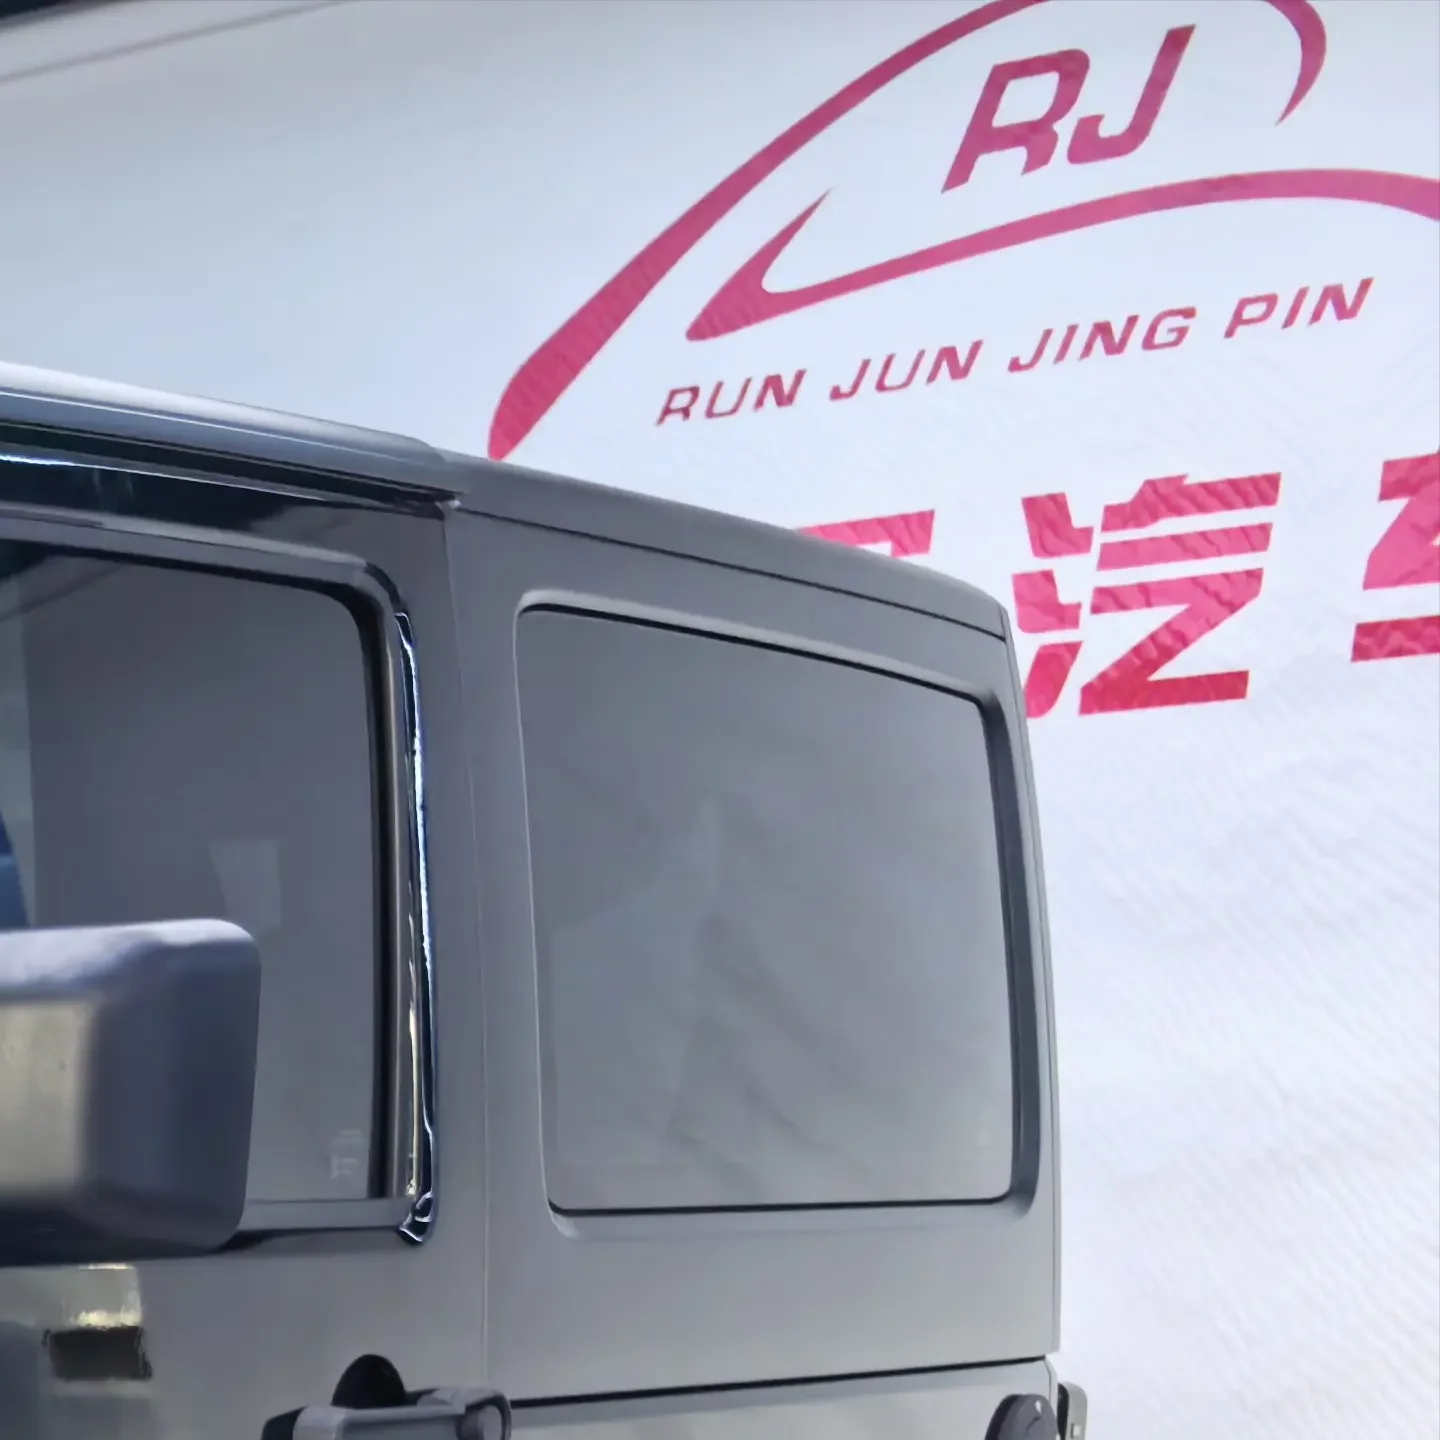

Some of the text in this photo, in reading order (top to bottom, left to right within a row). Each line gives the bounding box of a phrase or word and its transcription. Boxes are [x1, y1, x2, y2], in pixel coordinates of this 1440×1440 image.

[941, 24, 1197, 194] RJ
[655, 277, 1375, 425] RUN JUN JING PIN
